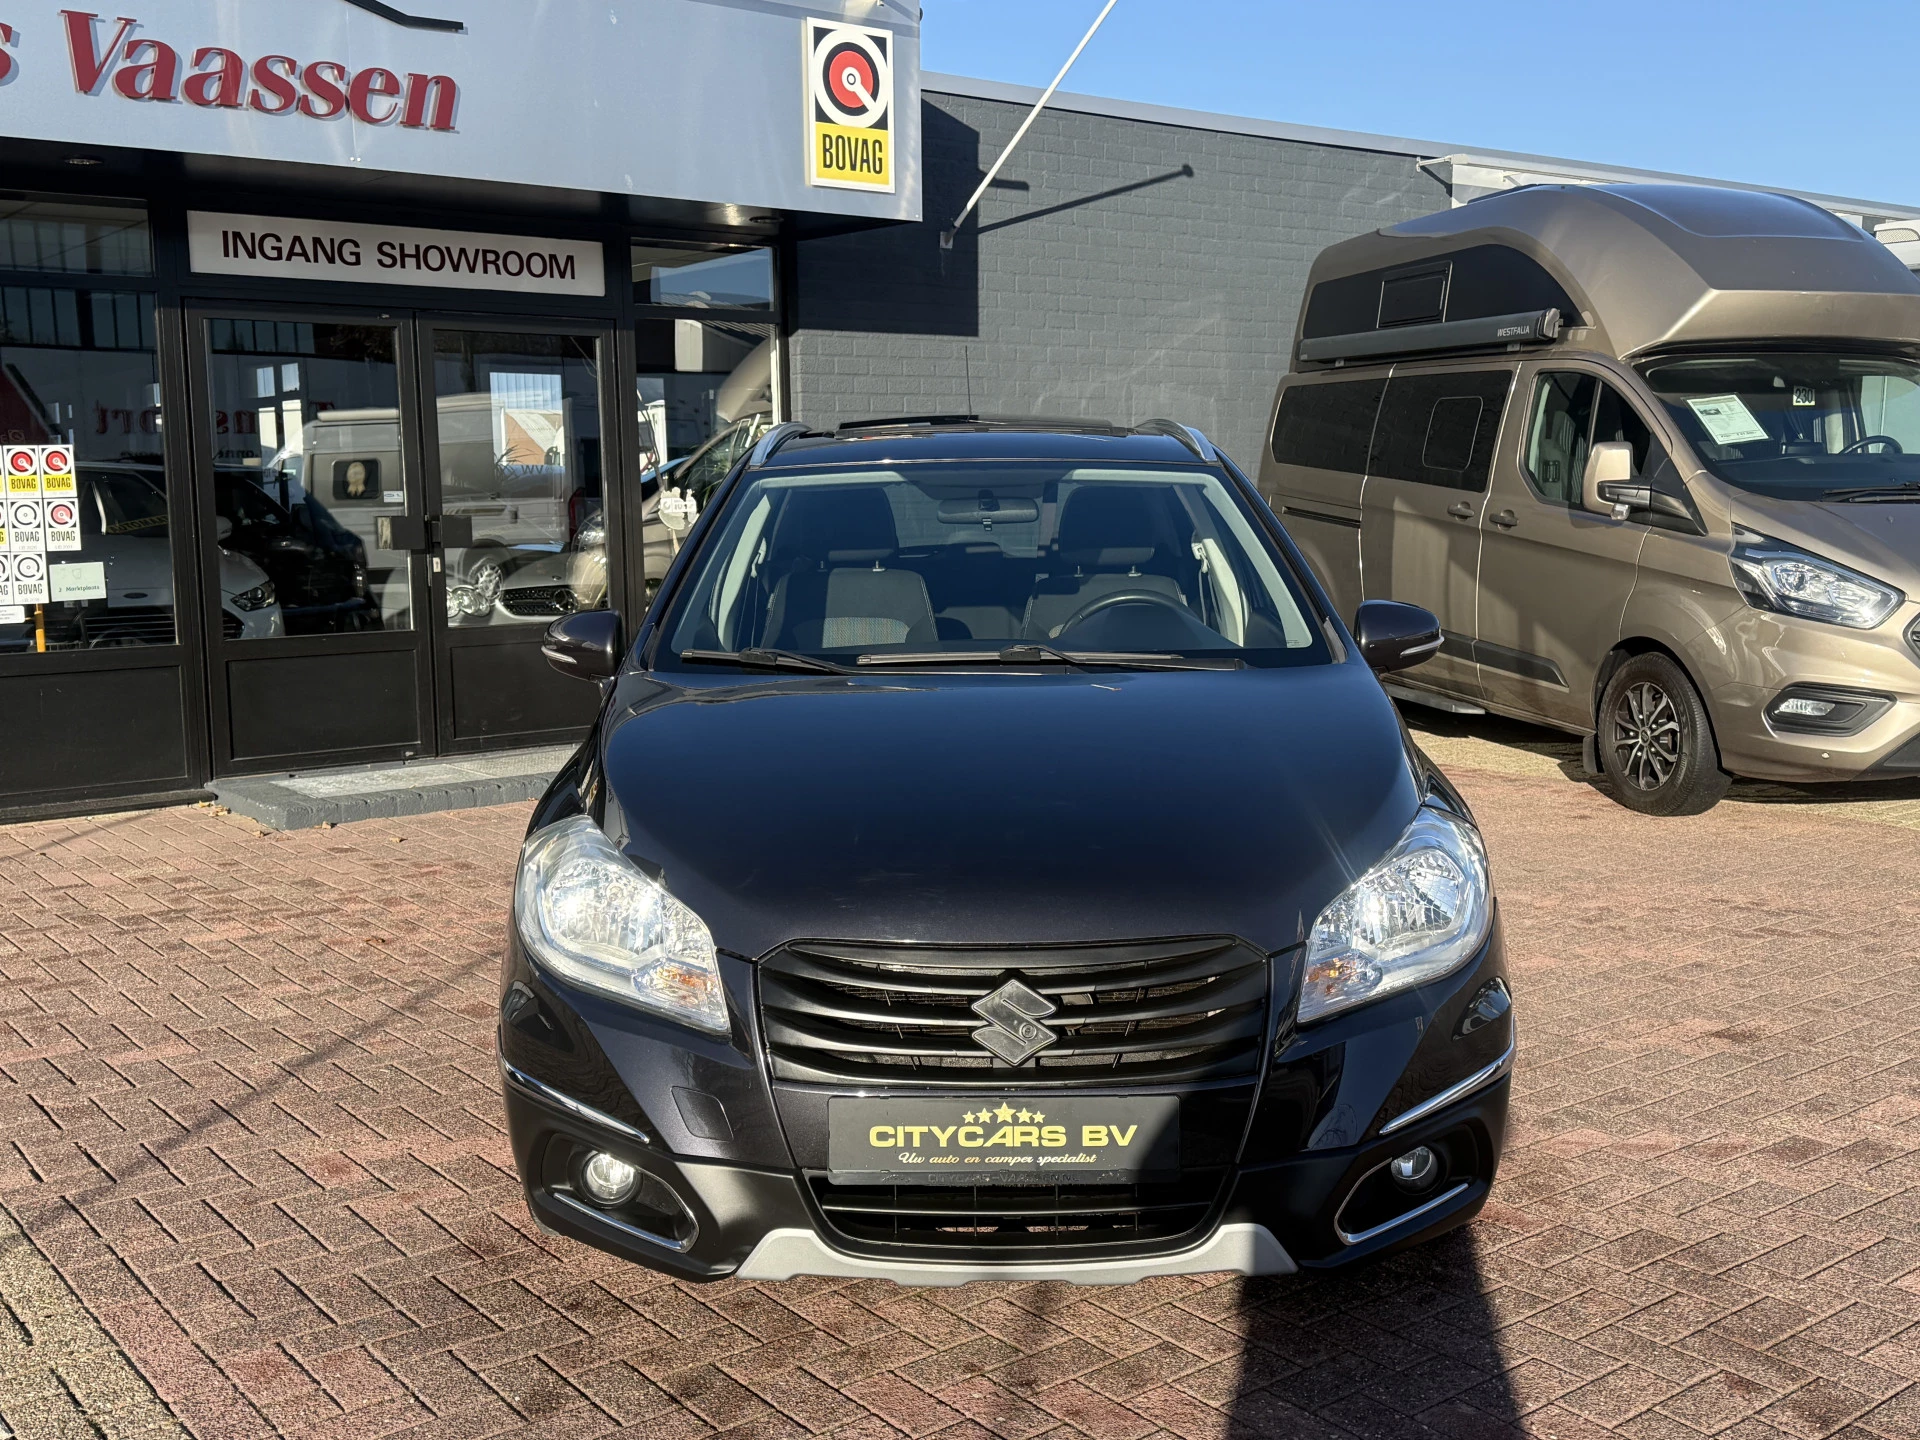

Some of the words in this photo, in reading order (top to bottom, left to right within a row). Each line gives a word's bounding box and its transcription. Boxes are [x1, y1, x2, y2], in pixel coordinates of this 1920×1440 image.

[60, 9, 459, 132] Vaassen
[821, 133, 883, 175] BOVAG
[221, 229, 361, 266] INGANG
[376, 241, 576, 280] SHOWROOM
[1497, 325, 1530, 337] WESTFALIA
[1795, 388, 1814, 404] 230
[11, 478, 37, 490] BOVAG
[46, 477, 71, 488] BOVAG
[15, 531, 40, 542] BOVAG
[51, 530, 76, 542] BOVAG
[18, 583, 43, 595] BOVAG
[869, 1125, 1067, 1148] CITYCARS
[1081, 1124, 1138, 1147] BV
[898, 1151, 925, 1164] Uw
[929, 1154, 960, 1164] auto
[964, 1156, 981, 1164] en
[984, 1155, 1034, 1167] camper
[1037, 1152, 1097, 1167] specialist
